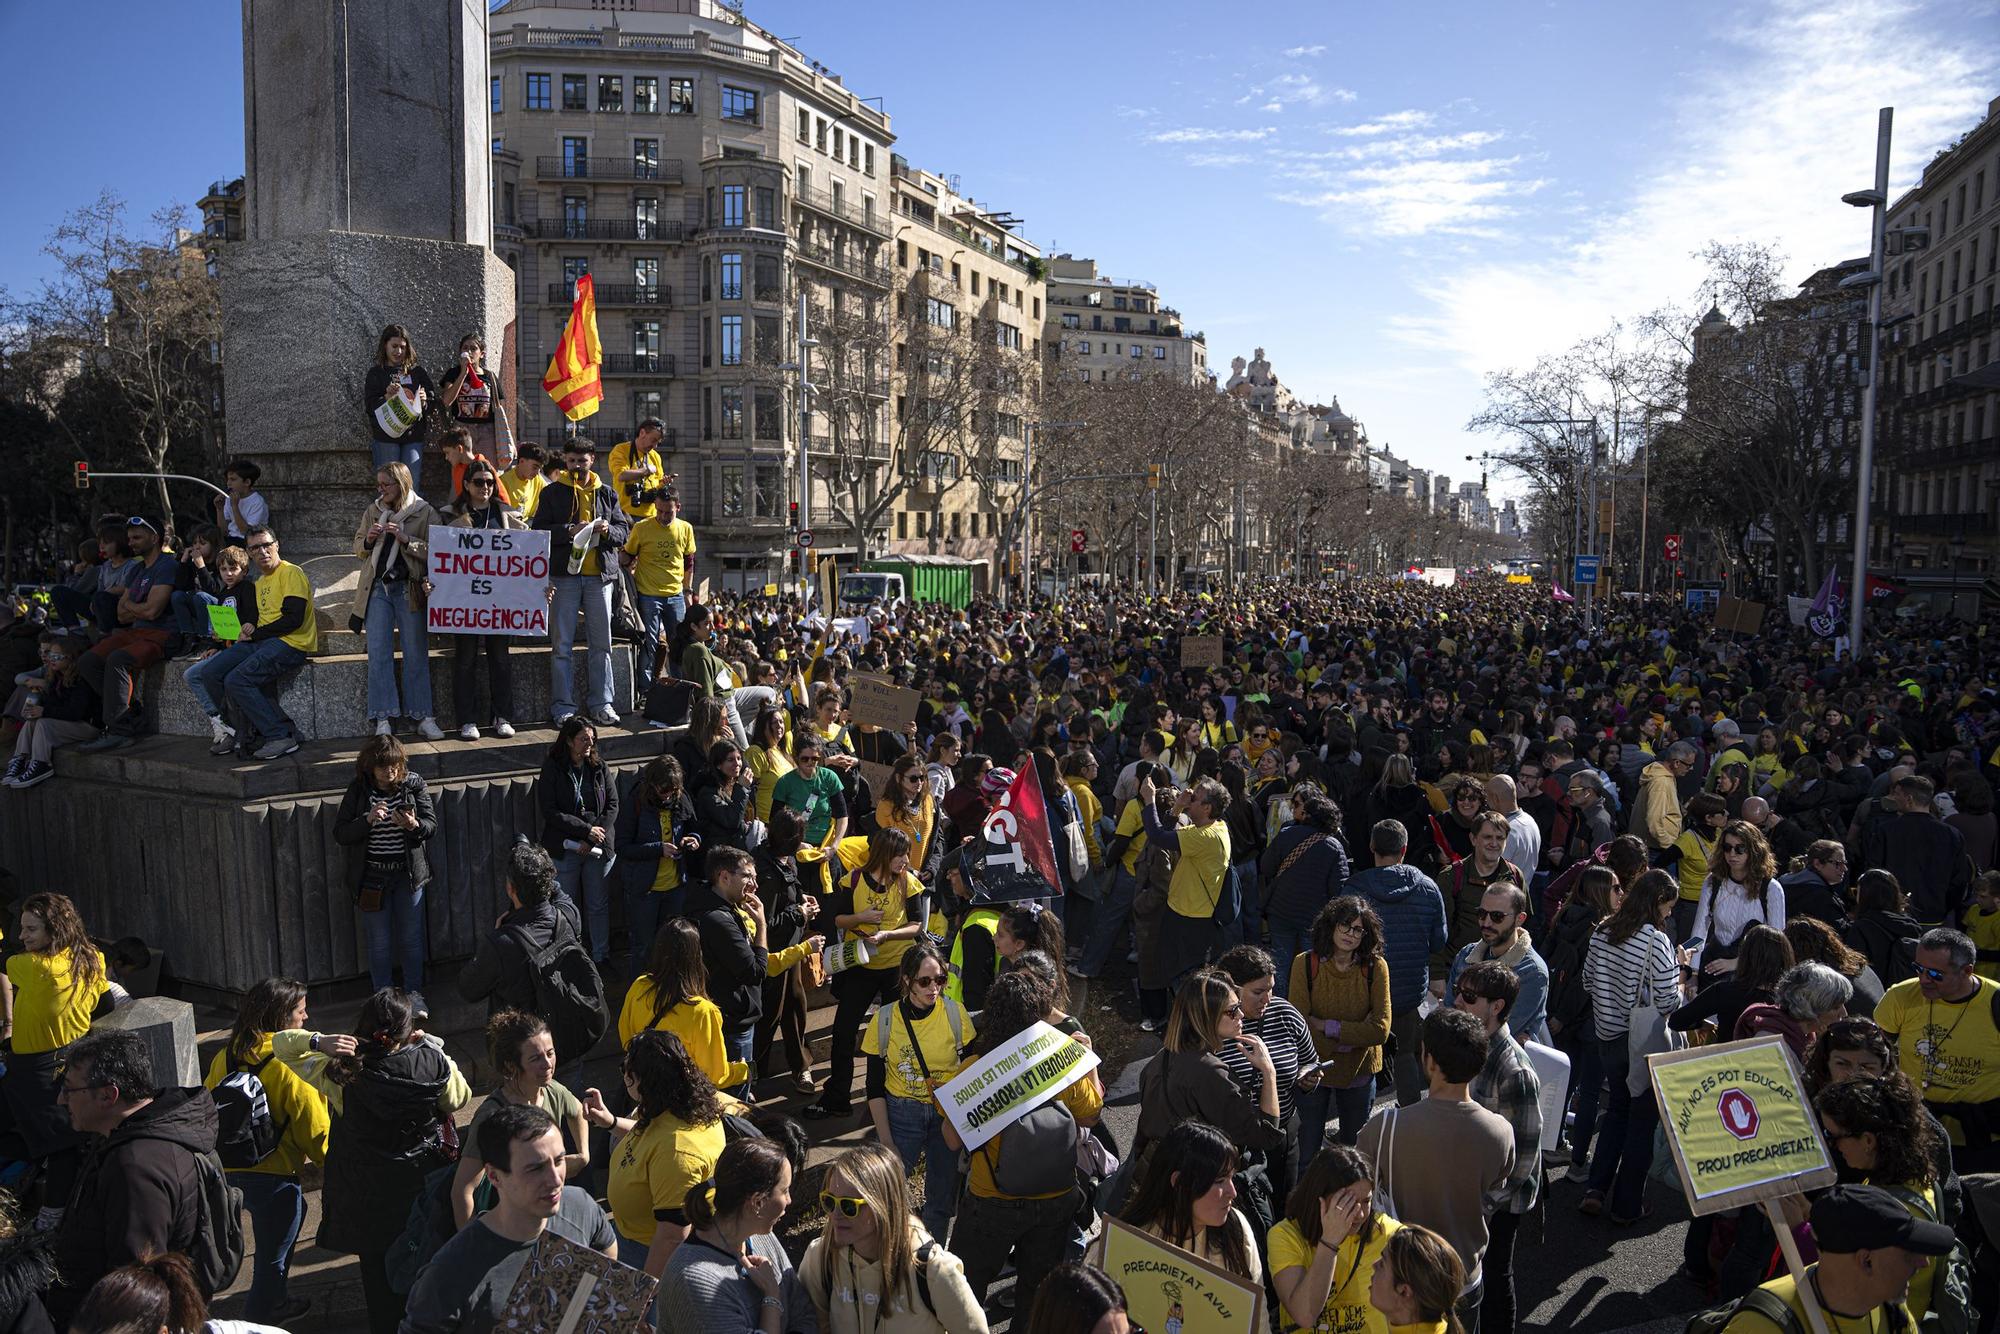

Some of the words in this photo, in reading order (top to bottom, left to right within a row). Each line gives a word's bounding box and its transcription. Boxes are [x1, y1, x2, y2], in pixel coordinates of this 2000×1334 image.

[458, 533, 484, 549] NO
[492, 531, 513, 551] ÉS
[657, 541, 675, 549] SOS
[471, 576, 492, 595] ÉS
[1872, 587, 1892, 597] CGT
[983, 790, 1026, 874] GT
[866, 897, 890, 906] SOS
[982, 1064, 999, 1085] LES
[1024, 1071, 1040, 1090] LA
[1688, 1088, 1703, 1110] NO
[1700, 1075, 1716, 1094] ES
[1718, 1070, 1740, 1084] POT
[1744, 1070, 1793, 1101] EDUCAR
[966, 1077, 1026, 1133] PROFESSIÓ
[1697, 1155, 1732, 1176] PROU
[1733, 1135, 1816, 1167] PRECARIETAT!
[1123, 1260, 1204, 1291] PRECARIETAT
[1203, 1291, 1233, 1319] AVUI
